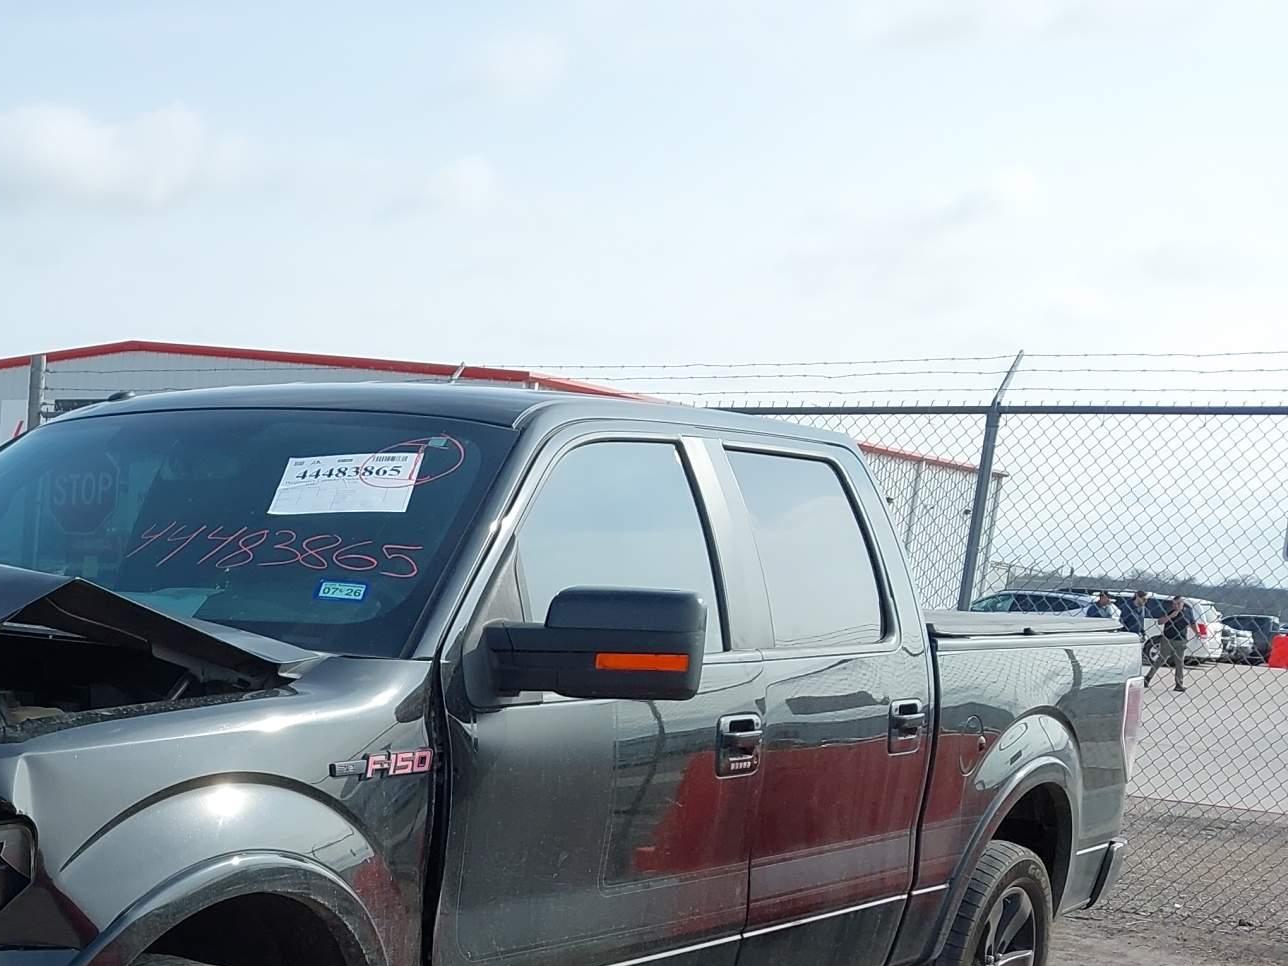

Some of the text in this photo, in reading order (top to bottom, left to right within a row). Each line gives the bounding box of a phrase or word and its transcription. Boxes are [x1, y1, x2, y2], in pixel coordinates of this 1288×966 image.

[295, 465, 403, 480] 44483865
[54, 472, 113, 506] STOP
[126, 521, 423, 577] 44483865
[322, 586, 362, 597] 07 26
[366, 750, 432, 779] F-150
